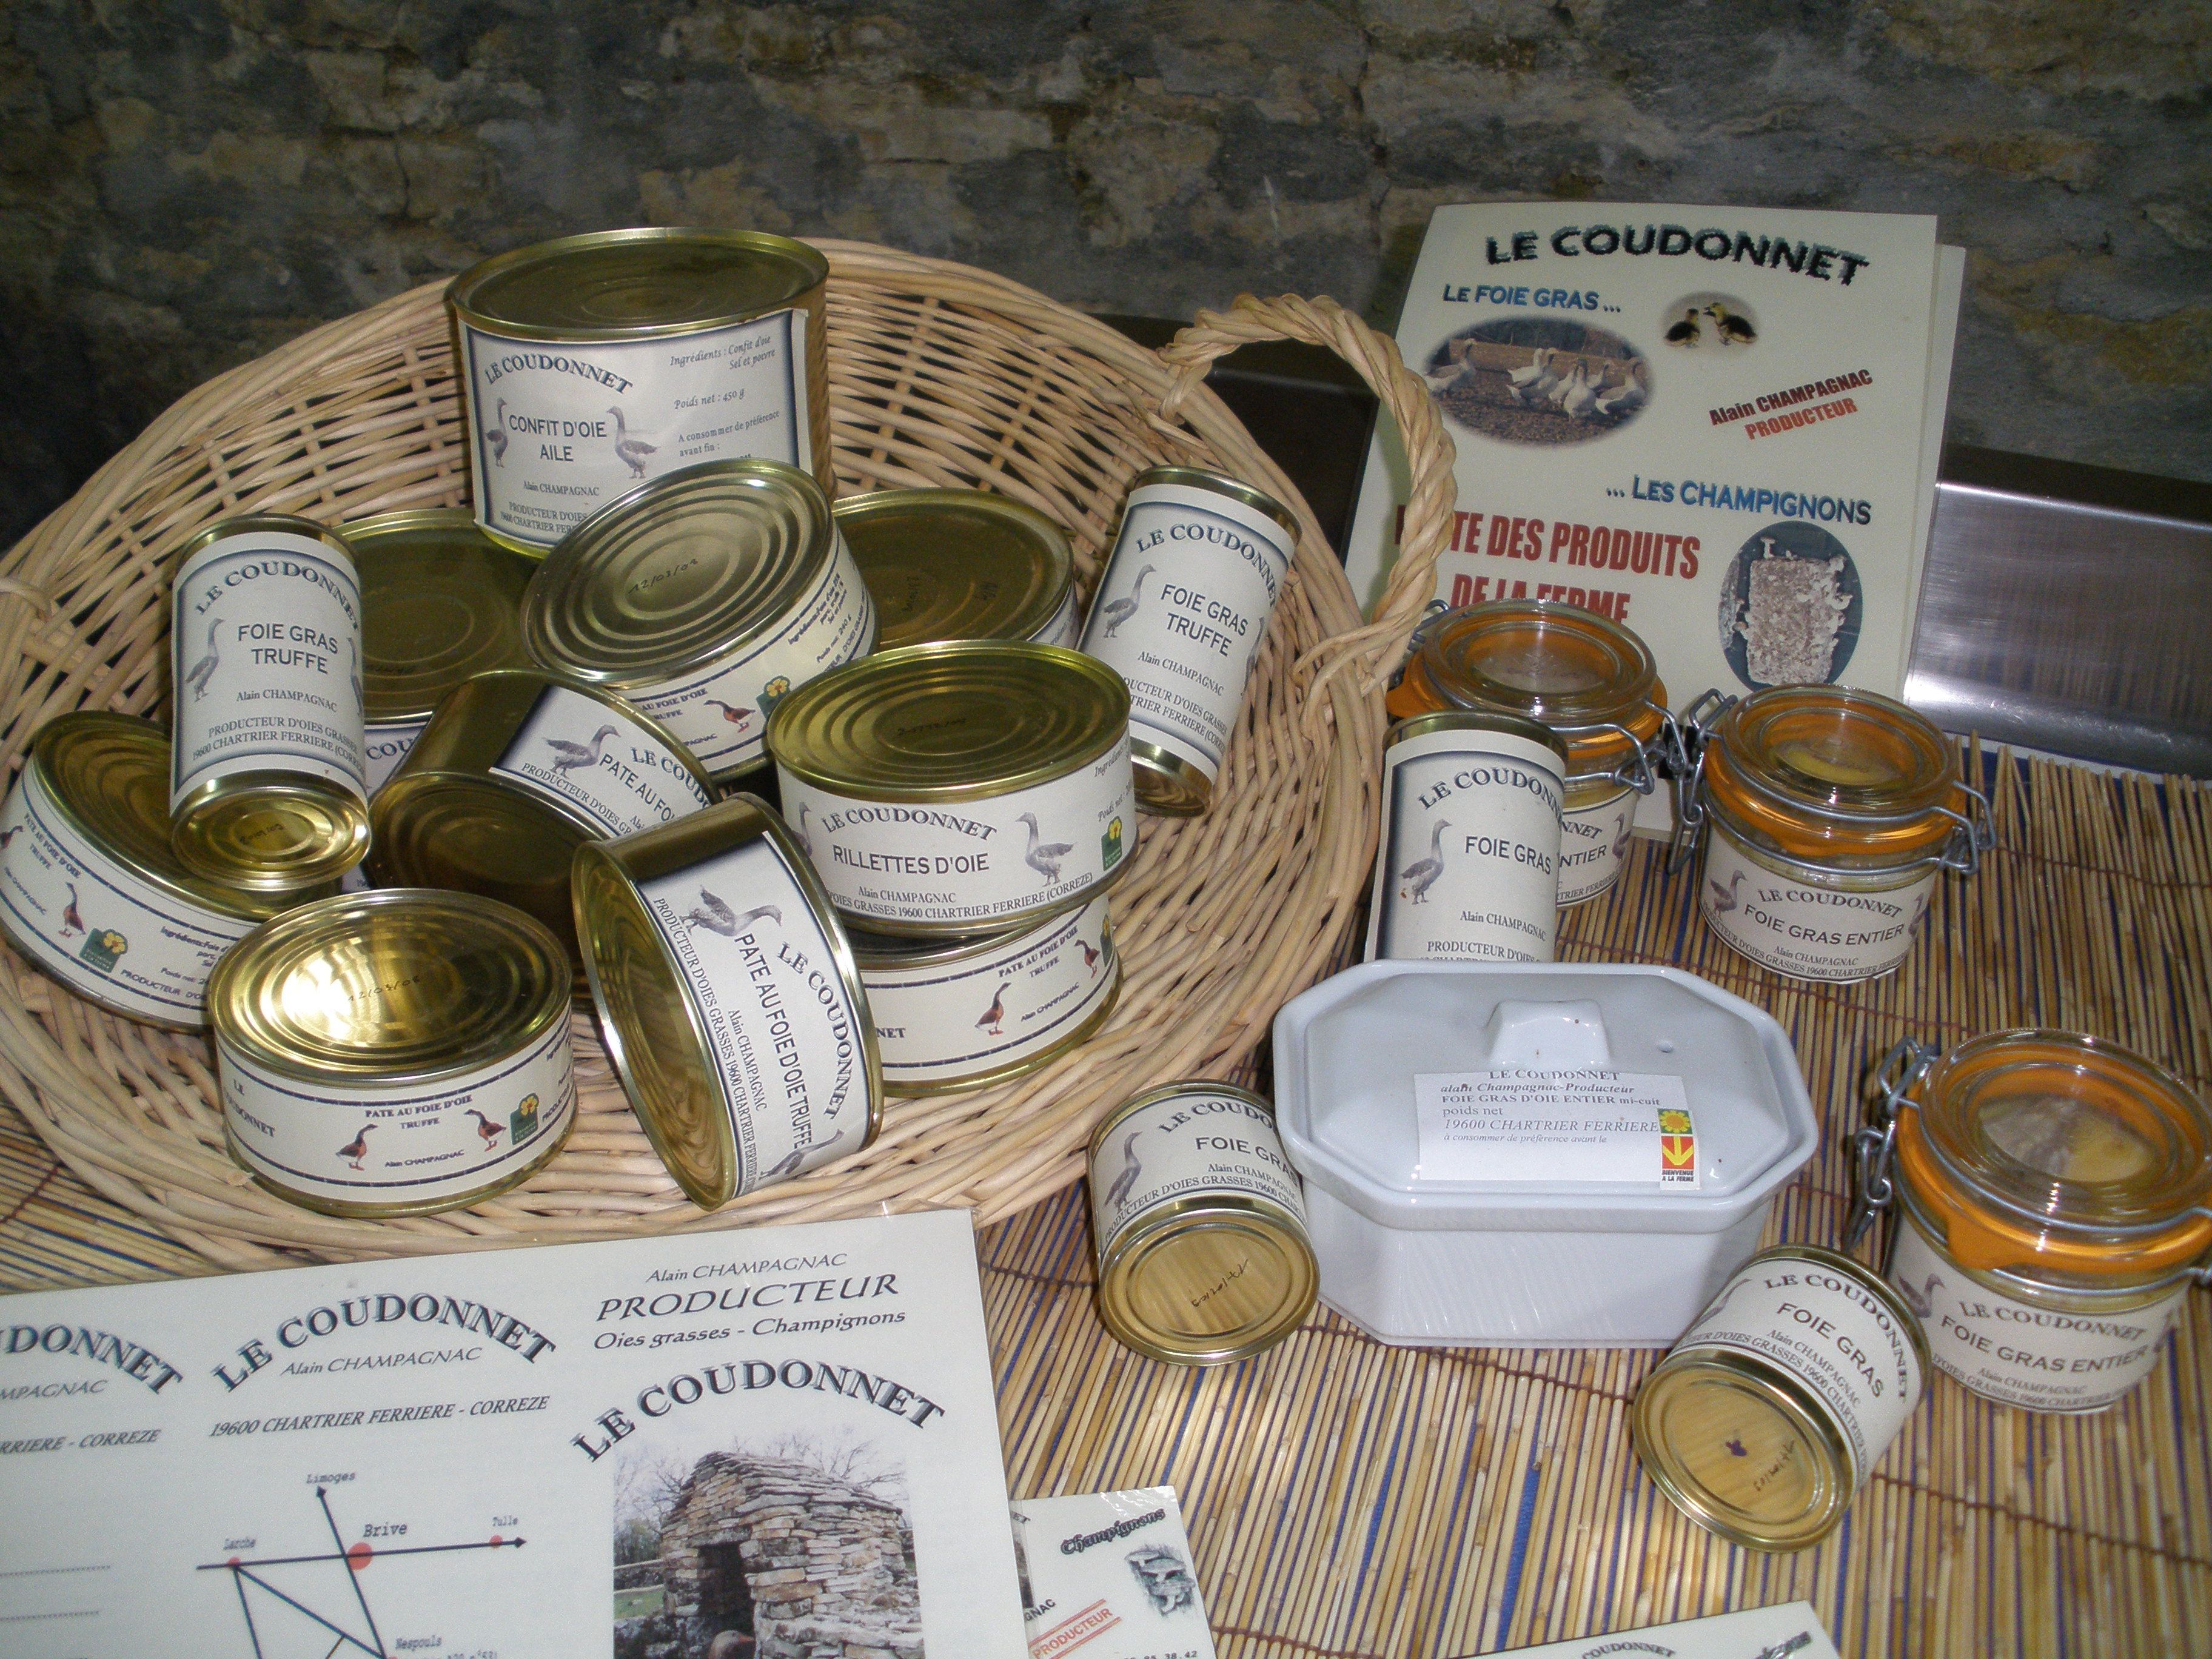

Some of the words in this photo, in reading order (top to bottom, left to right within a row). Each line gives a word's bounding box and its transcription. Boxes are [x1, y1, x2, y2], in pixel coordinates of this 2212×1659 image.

[1484, 229, 1538, 266] LE
[1550, 223, 1871, 287] COUDONNET
[1474, 286, 1530, 308] FOIE
[1532, 287, 1601, 312] GRAS
[485, 360, 503, 384] LE
[501, 354, 633, 395] COUDONNET
[674, 395, 698, 409] Poids
[702, 394, 715, 404] net
[723, 392, 737, 402] 450
[1708, 404, 1755, 427] Alain
[1754, 367, 1874, 418] CHAMPAGNAC
[509, 414, 560, 437] CONFIT
[562, 421, 607, 438] D'OIE
[686, 426, 732, 441] consommer
[734, 421, 743, 431] de
[1743, 397, 1858, 441] PRODUCTEUR
[539, 444, 574, 462] AILE
[679, 446, 702, 457] avant
[540, 483, 600, 496] CHAMPAGNAC
[1632, 473, 1675, 503] LES
[1679, 478, 1873, 526] CHAMPIGNONS
[1135, 528, 1165, 554] LE
[1486, 512, 1543, 561] DES
[1548, 520, 1701, 580] PRODUITS
[195, 585, 223, 615] LE
[1161, 584, 1205, 613] FOIE
[1207, 600, 1248, 637] GRAS
[237, 623, 284, 642] FOIE
[289, 625, 338, 655] GRAS
[1167, 612, 1232, 657] TRUFFE
[251, 648, 329, 675] TRUFFE
[1138, 651, 1161, 667] Alain
[1162, 659, 1224, 696] CHAMPAGNAC
[236, 691, 261, 702] Alain
[263, 689, 338, 712] CHAMPAGNAC
[207, 717, 284, 739] PRODUCTEUR
[212, 731, 278, 750] CHARTRIER
[281, 732, 334, 751] FERRIERE
[631, 746, 657, 767] LE
[521, 762, 590, 803] PRODUCTEUR
[589, 799, 620, 825] D'OIES
[599, 753, 639, 789] PATE
[635, 782, 657, 806] AU
[1418, 780, 1452, 810] LE
[822, 814, 846, 833] LE
[845, 807, 997, 841] COUDONNET
[833, 844, 930, 874] RILLETTES
[935, 853, 990, 874] D'OIE
[1464, 836, 1510, 859] FOIE
[1514, 844, 1552, 875] GRAS
[853, 899, 897, 916] GRASSES
[925, 903, 992, 919] CHARTRIER
[992, 888, 1047, 914] FERRIERE
[880, 889, 957, 903] CHAMPAGNAC
[1758, 888, 1783, 902] LE
[1787, 889, 1903, 919] COUDONNET
[1460, 910, 1484, 922] Alain
[1486, 913, 1547, 942] CHAMPAGNAC
[1744, 903, 1785, 933] FOIE
[1788, 924, 1842, 945] GRAS
[1845, 923, 1905, 946] ENTIER
[734, 933, 772, 982] PATE
[998, 963, 1025, 977] PATE
[1025, 956, 1039, 967] AU
[1039, 942, 1061, 959] FOIE
[1060, 925, 1078, 948] D'OIE
[1427, 940, 1504, 958] PRODUCTEUR
[1765, 953, 1805, 973] GRASSES
[1794, 952, 1858, 965] CHAMPAGNAC
[654, 897, 700, 968] PRODUCTEUR
[692, 967, 717, 1008] D'OIES
[709, 1008, 735, 1059] GRASSES
[1029, 956, 1060, 978] TRUFFE
[121, 969, 181, 997] PRODUCTEUR
[756, 984, 782, 1008] AU
[765, 1009, 796, 1055] FOIE
[777, 940, 808, 974] LE
[807, 971, 853, 1121] COUDONNET
[735, 1033, 768, 1111] CHAMPAGNAC
[779, 1051, 807, 1099] D'OIE
[1489, 1071, 1512, 1080] LE
[1515, 1069, 1621, 1081] COUDONNET
[365, 1108, 395, 1119] PATE
[415, 1101, 443, 1114] FOIE
[1441, 1094, 1475, 1104] FOIE
[1478, 1094, 1517, 1103] GRAS
[1521, 1094, 1560, 1104] D'OIE
[1563, 1094, 1616, 1105] ENTIER
[1619, 1096, 1660, 1105] mi-cuit
[1442, 1105, 1480, 1117] poids
[1483, 1106, 1503, 1116] net
[400, 1116, 440, 1130] TRUFFE
[789, 1094, 812, 1149] TRUFFE
[1158, 1111, 1191, 1133] LE
[1445, 1119, 1486, 1130] 19600
[1489, 1119, 1578, 1131] CHARTRIER
[1584, 1119, 1659, 1133] FERRIERE
[1196, 1137, 1251, 1155] FOIE
[1452, 1133, 1504, 1142] consommer
[1520, 1134, 1569, 1144] préférence
[1570, 1134, 1597, 1144] avant
[1201, 1176, 1253, 1186] GRASSES
[645, 1268, 688, 1284] Alain
[691, 1252, 848, 1279] CHAMPAGNAC
[1763, 1274, 1798, 1290] LE
[595, 1272, 899, 1322] PRODUCTEUR
[592, 1332, 645, 1350] Oies
[648, 1326, 731, 1349] grasses
[751, 1310, 907, 1336] Champignons
[1959, 1301, 1991, 1318] LE
[1996, 1305, 2147, 1342] COUDONNET
[210, 1338, 275, 1393] LE
[276, 1291, 558, 1366] COUDONNET
[1777, 1302, 1836, 1339] FOIE
[1836, 1335, 1884, 1399] GRAS
[1940, 1315, 1992, 1354] FOIE
[1997, 1346, 2066, 1373] GRAS
[2071, 1344, 2148, 1373] ENTIER
[281, 1359, 324, 1378] Alain
[327, 1346, 484, 1373] CHAMPAGNAC
[209, 1419, 261, 1439] 19600
[262, 1410, 366, 1433] CHARTRIER
[367, 1403, 455, 1425] FERRIERE
[470, 1395, 552, 1416] CORREZE
[570, 1406, 637, 1463] LE
[637, 1357, 946, 1429] COUDONNET
[78, 1429, 161, 1448] CORREZE
[305, 1470, 357, 1485] Limoges
[363, 1523, 408, 1537] Brive
[1061, 1508, 1166, 1555] Champignons
[1031, 1607, 1114, 1658] PRODUCTEUR
[1583, 1641, 1676, 1659] COUDONNET
